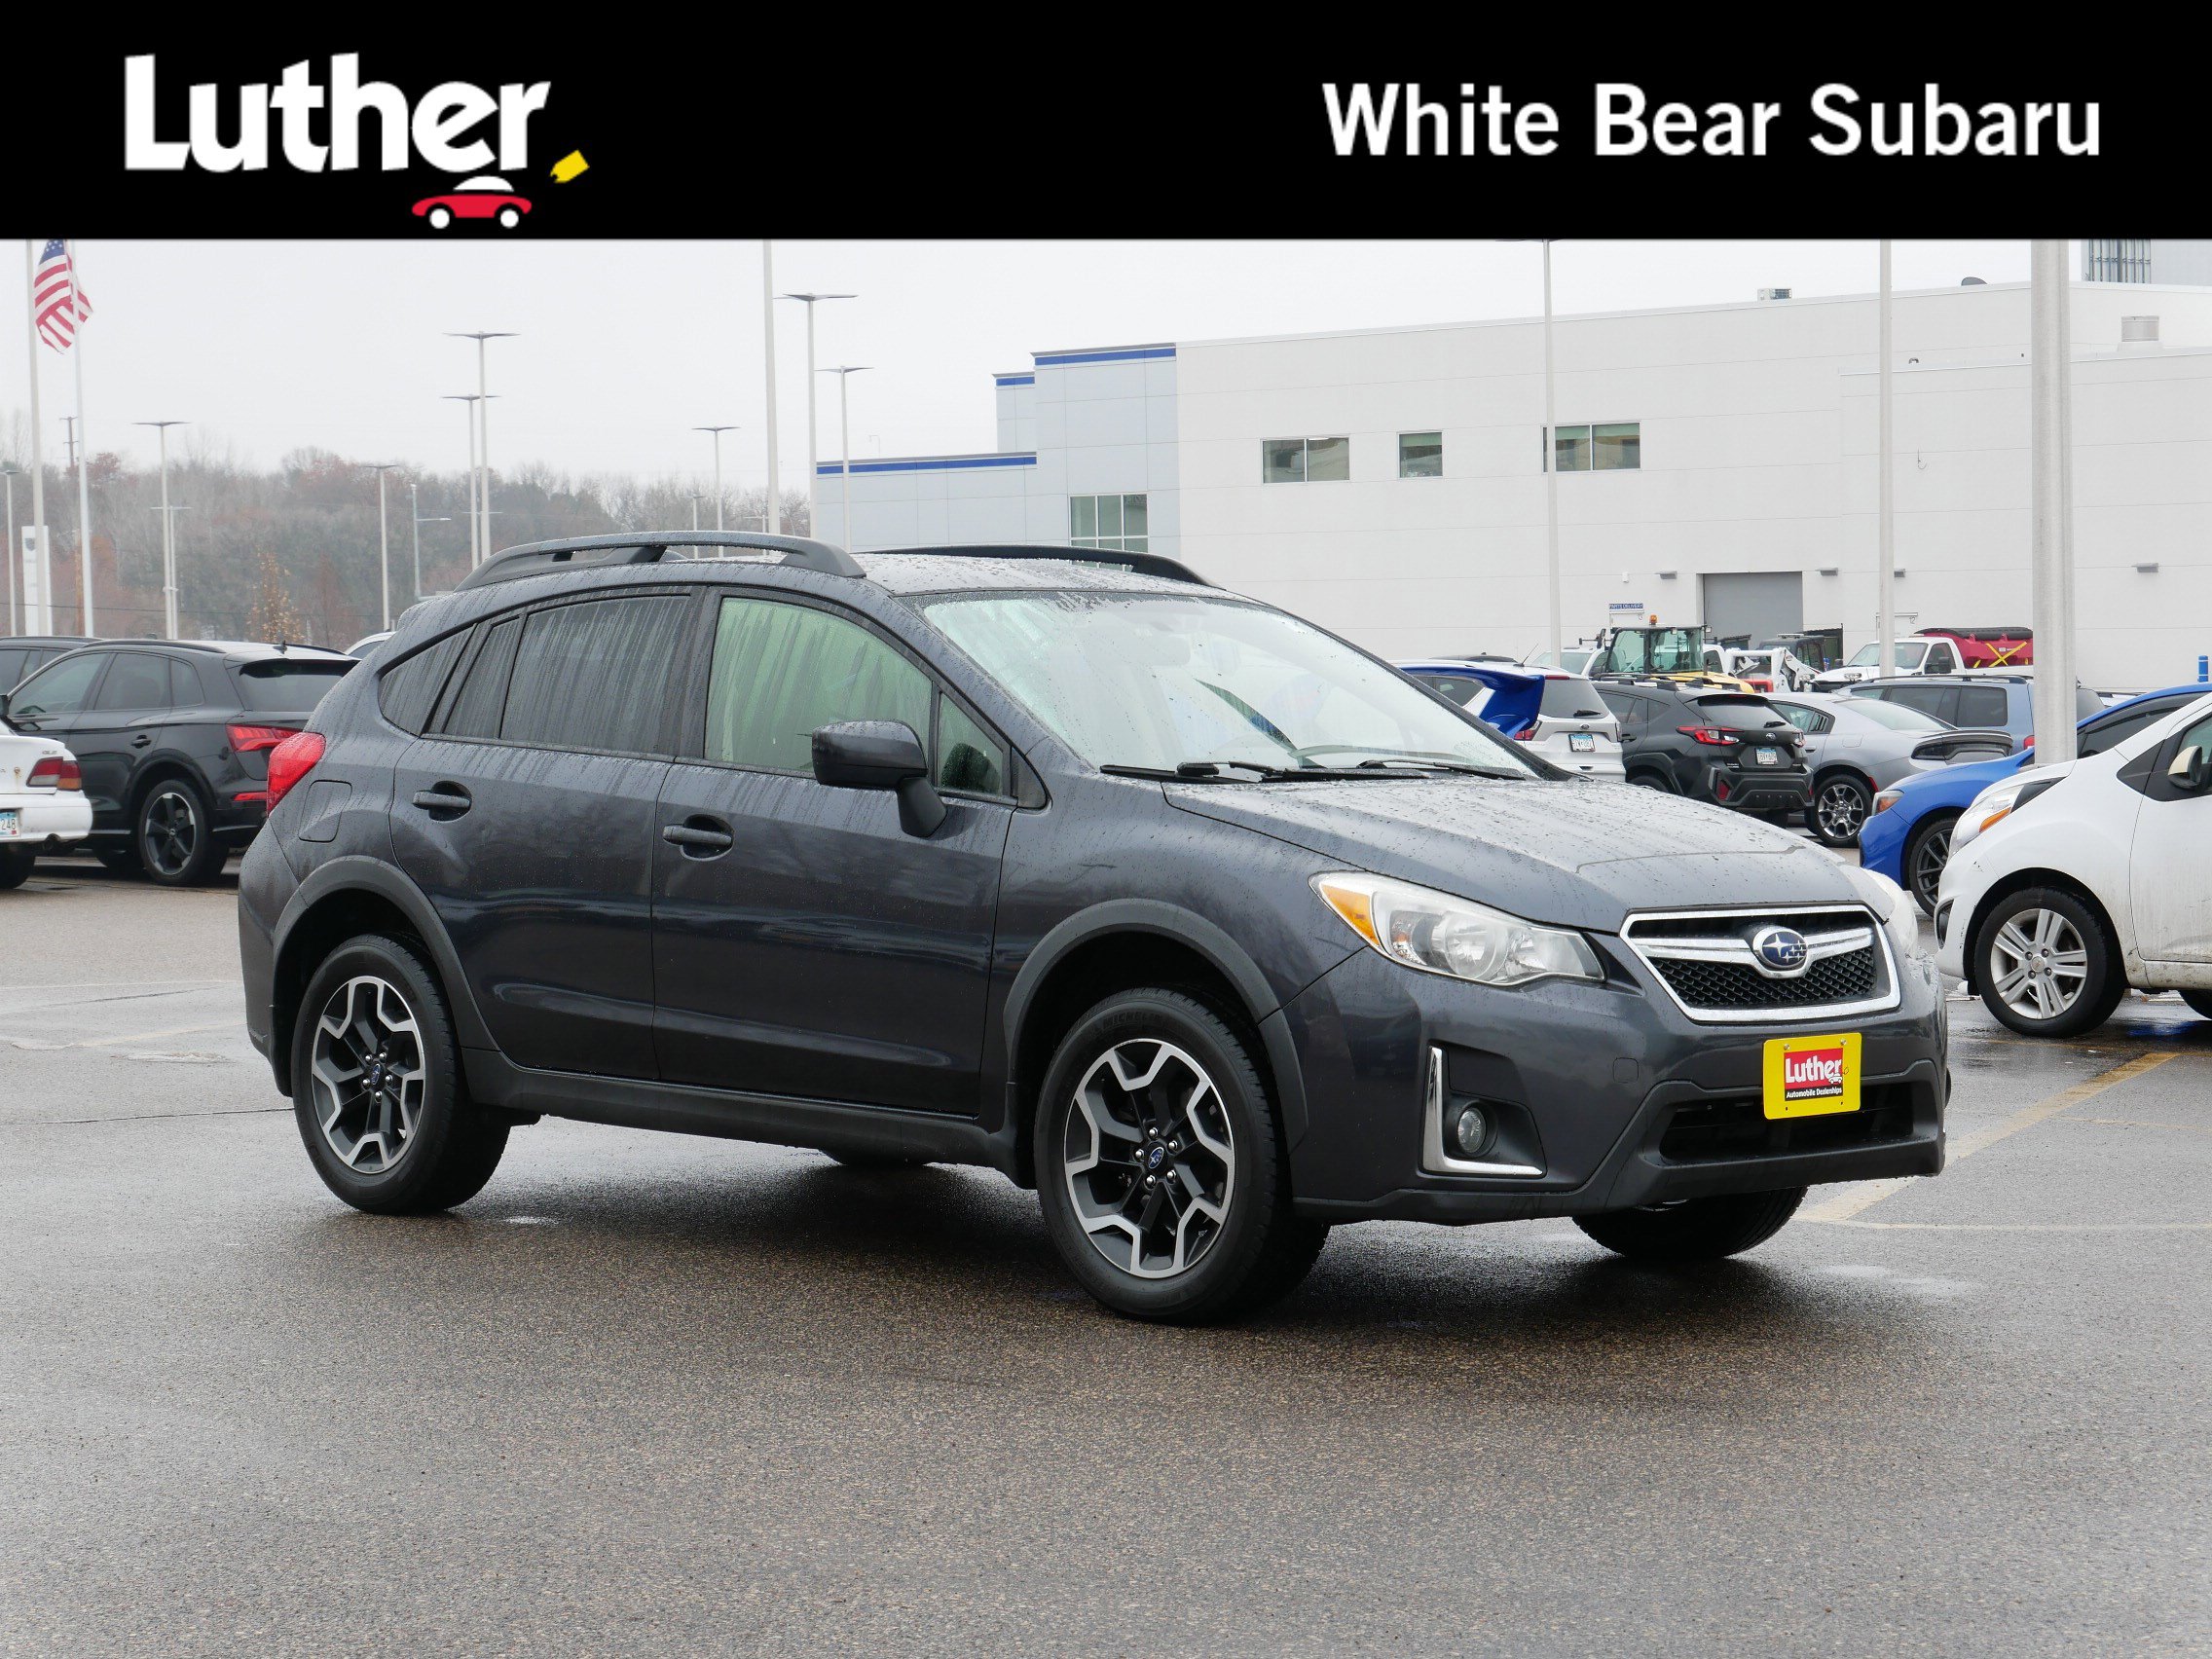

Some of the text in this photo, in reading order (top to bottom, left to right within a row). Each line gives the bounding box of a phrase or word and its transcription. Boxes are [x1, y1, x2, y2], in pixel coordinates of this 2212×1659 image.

[1785, 1055, 1842, 1083] Luther
[1787, 1087, 1842, 1098] Automobile Dealerships
